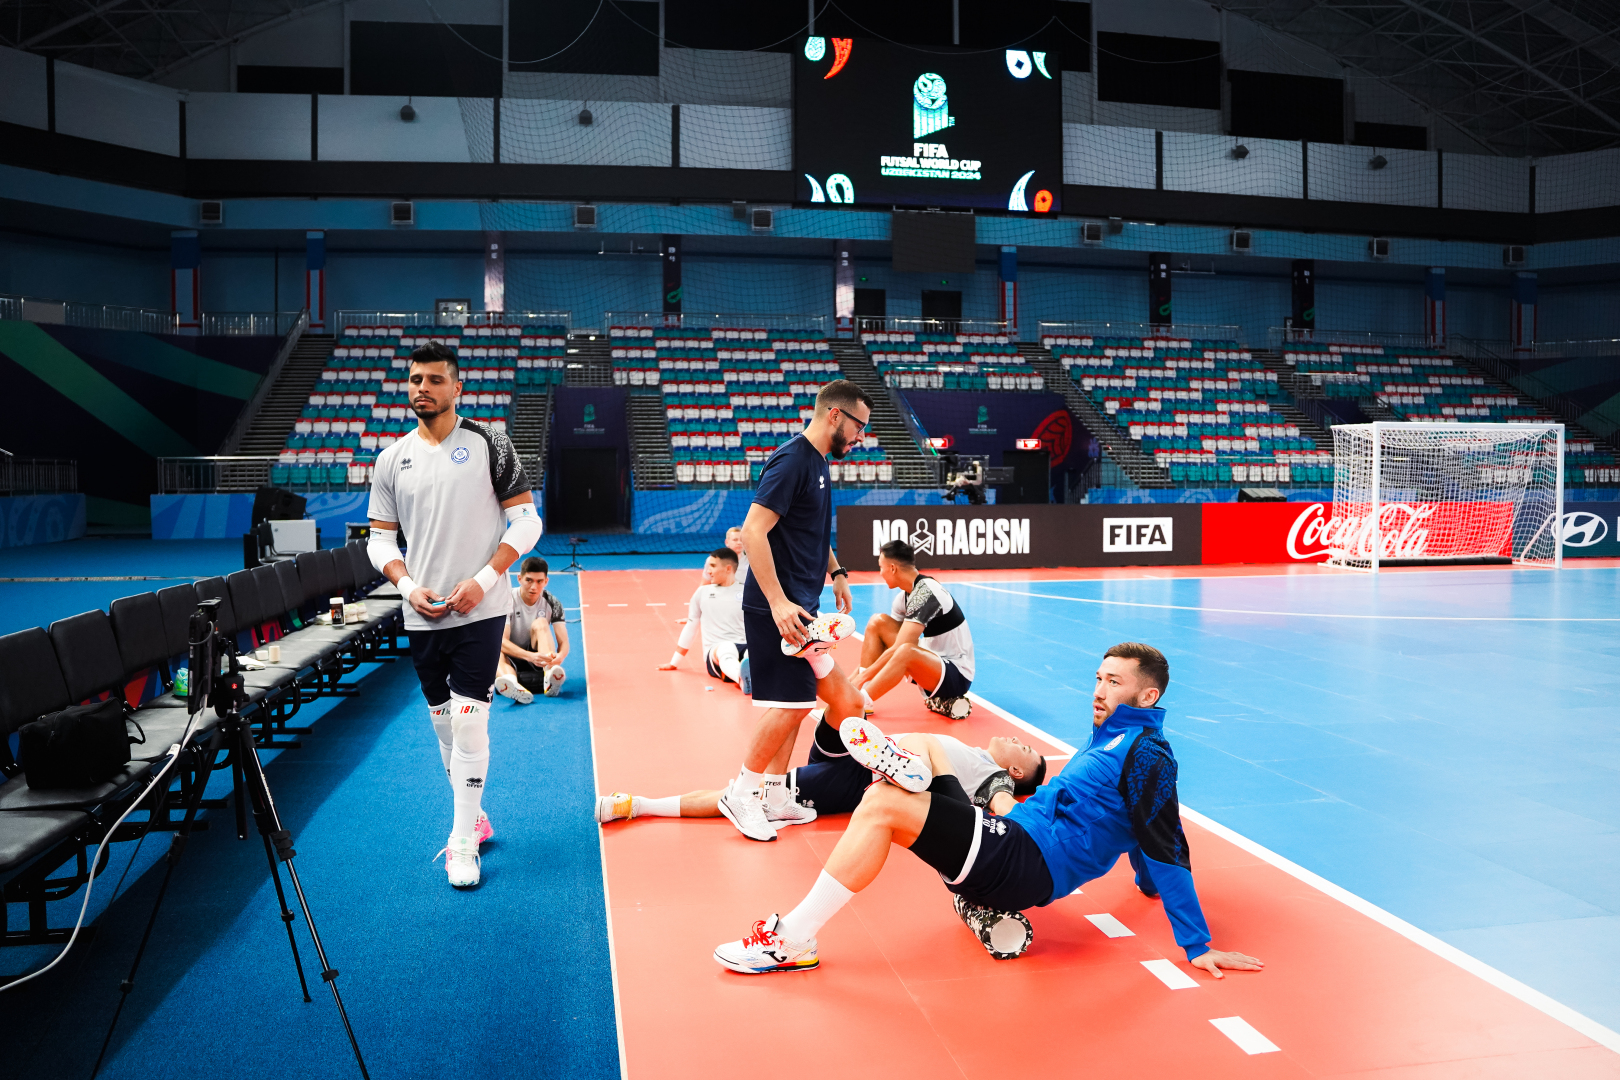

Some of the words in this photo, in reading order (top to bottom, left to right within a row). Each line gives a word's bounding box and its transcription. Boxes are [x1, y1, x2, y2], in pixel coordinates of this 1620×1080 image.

[914, 143, 949, 158] FIFA
[881, 156, 920, 168] FUTSAL
[919, 158, 959, 170] WORLD
[960, 160, 982, 171] CUP
[881, 167, 950, 178] UZBEKISTAN
[951, 171, 982, 180] 2024
[872, 519, 909, 556] NO
[936, 518, 1030, 555] RACISM
[1109, 524, 1167, 546] FIFA
